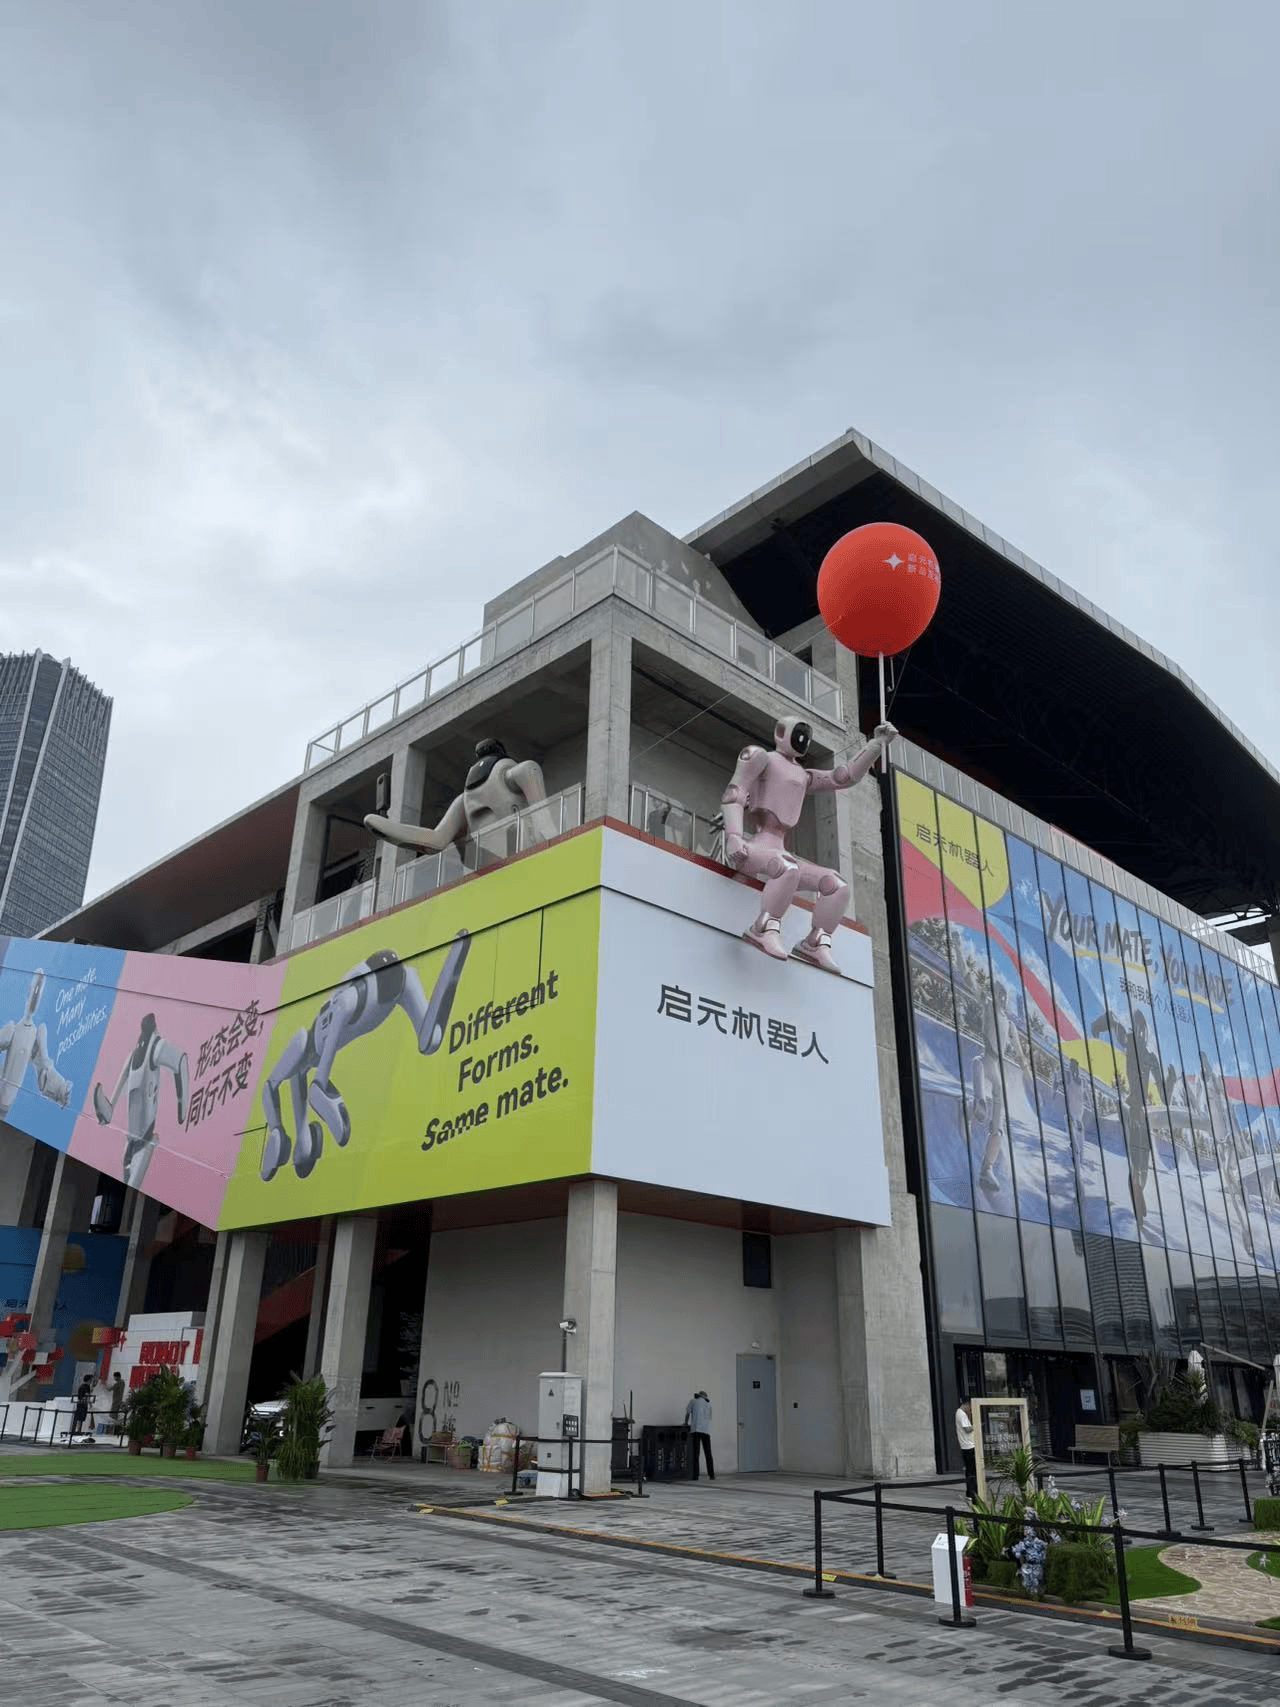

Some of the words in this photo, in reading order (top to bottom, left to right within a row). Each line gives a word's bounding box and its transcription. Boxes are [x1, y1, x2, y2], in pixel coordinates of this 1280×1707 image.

[916, 823, 995, 878] 启元机器人
[1041, 890, 1098, 949] YOUR
[1158, 944, 1190, 988] YOU
[56, 987, 75, 1013] One
[56, 996, 87, 1036] Many
[448, 969, 559, 1055] Different
[656, 983, 830, 1065] 启元机器人
[184, 1051, 254, 1133] 同行不变
[457, 1032, 540, 1093] Forms.
[420, 1101, 490, 1152] Same
[496, 1065, 570, 1120] mate.
[418, 1378, 439, 1445] 8
